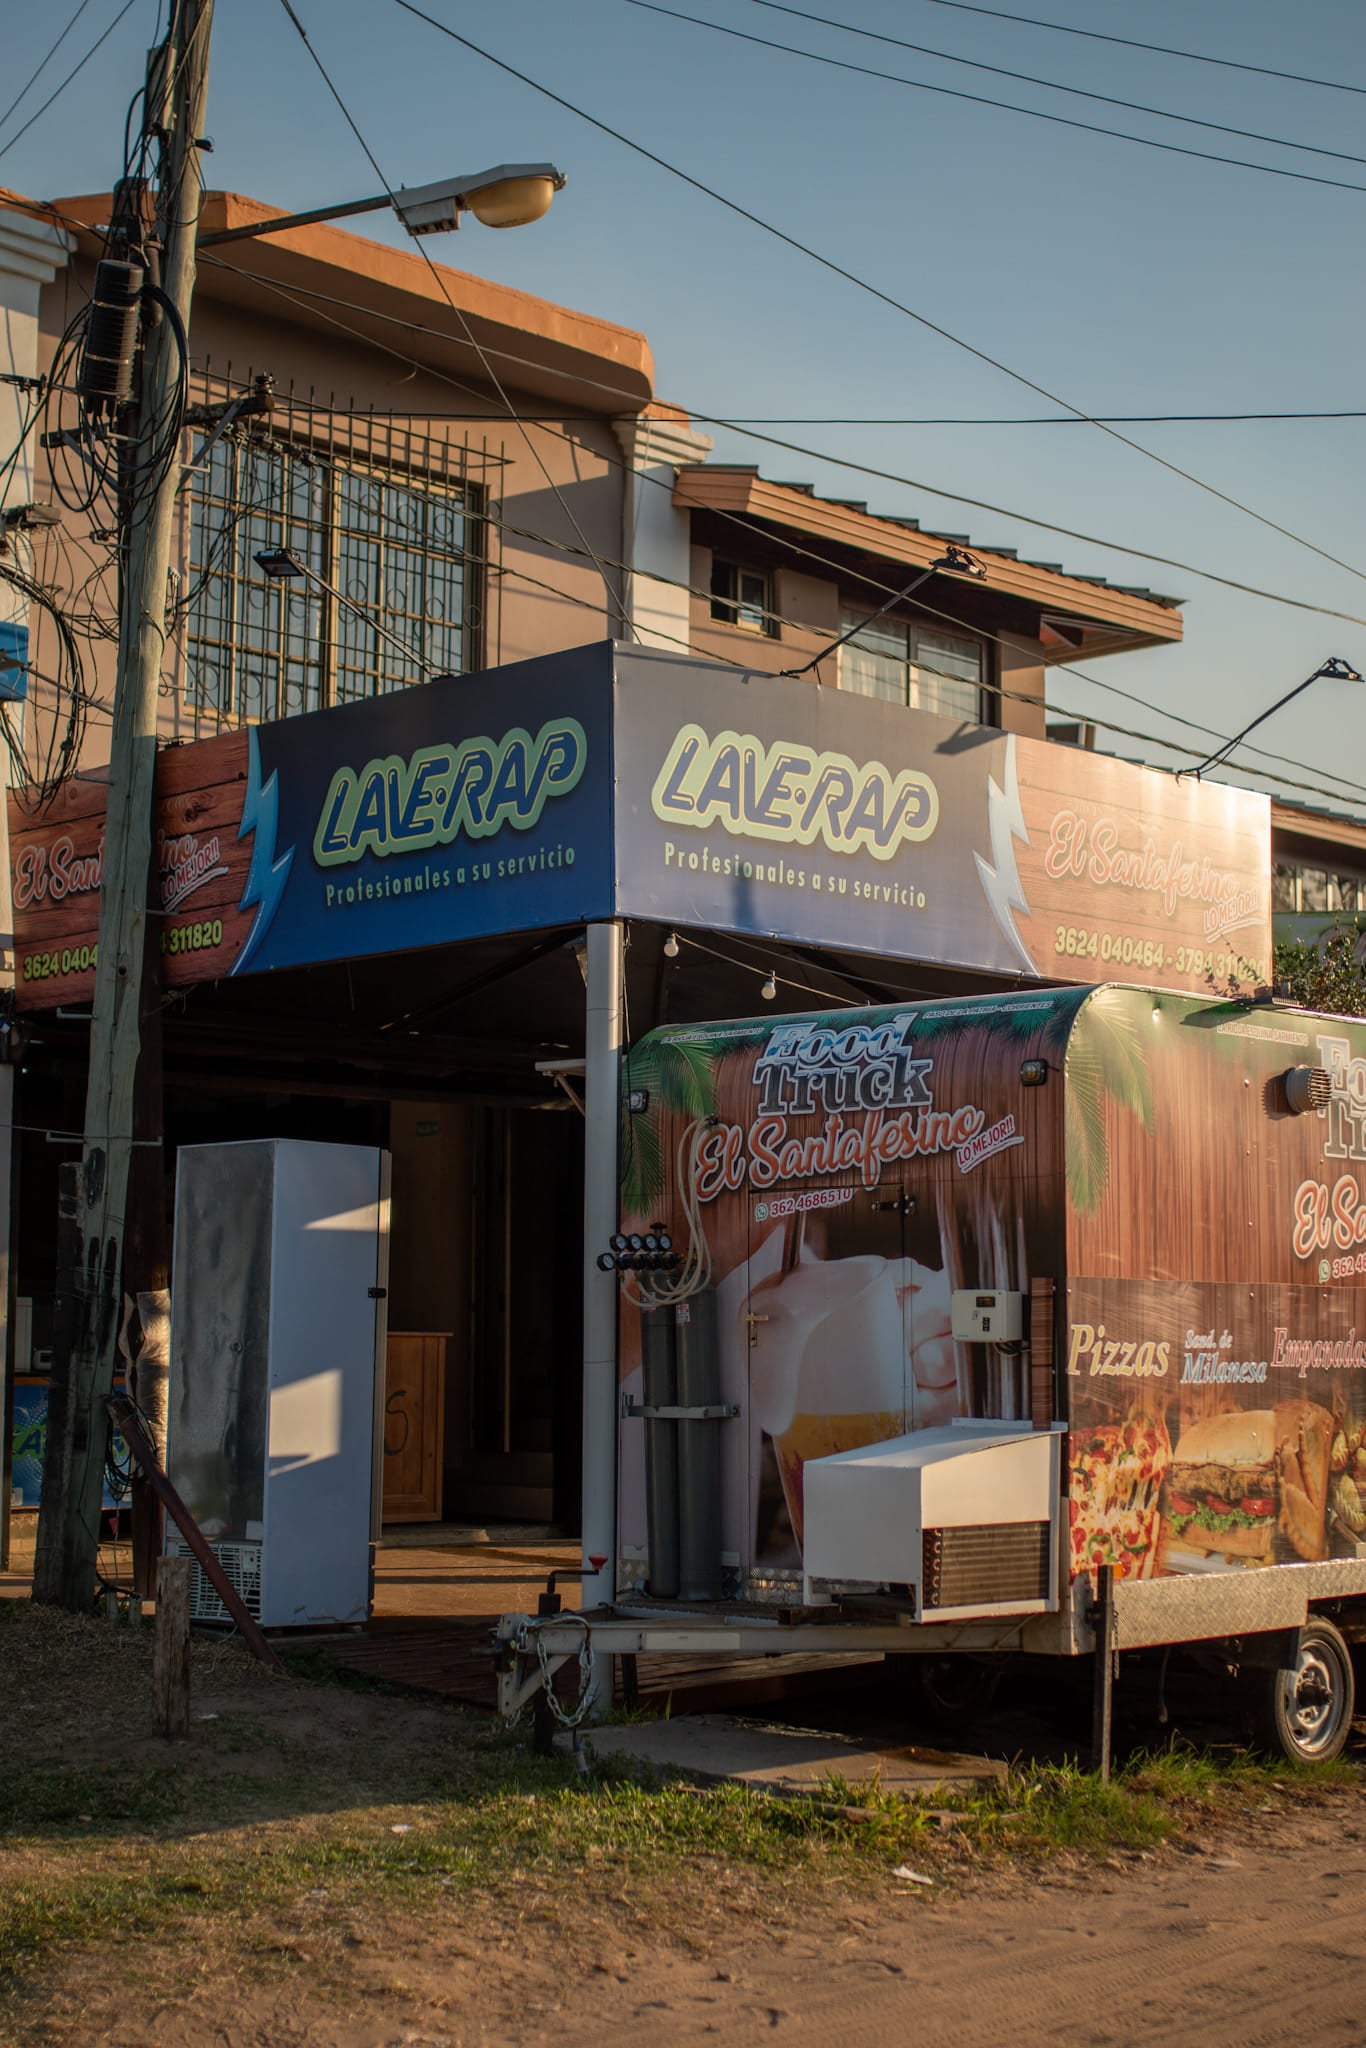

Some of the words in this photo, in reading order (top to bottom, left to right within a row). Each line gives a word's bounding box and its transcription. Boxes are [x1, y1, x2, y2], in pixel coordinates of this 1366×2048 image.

[14, 845, 47, 909] El
[326, 865, 450, 907] Profesionales
[456, 863, 466, 884] a
[472, 857, 492, 881] su
[497, 844, 576, 878] servicio
[664, 841, 806, 888] Profesionales
[811, 873, 822, 890] a
[828, 875, 848, 895] su
[853, 880, 926, 909] servicio
[1045, 810, 1087, 879] El
[1088, 817, 1240, 915] Santafesino
[1203, 906, 1218, 935] LO
[24, 951, 59, 981] 3624
[62, 943, 99, 974] 0404
[169, 919, 223, 953] 311820
[1055, 925, 1098, 959] 3624
[1101, 933, 1165, 969] 040464
[1175, 946, 1214, 976] 3794
[764, 1012, 918, 1068] Food
[753, 1046, 934, 1117] Truck
[695, 1122, 746, 1203] El
[748, 1105, 985, 1191] Santafesino
[957, 1146, 971, 1167] LO
[972, 1115, 1015, 1157] MEJOR!!
[770, 1199, 795, 1217] 362
[797, 1187, 852, 1211] 4686510
[1293, 1180, 1331, 1259] El
[1333, 1256, 1355, 1278] 362
[1067, 1324, 1171, 1378] Pizzas
[1219, 1329, 1233, 1349] de
[1180, 1352, 1268, 1384] Milanesa
